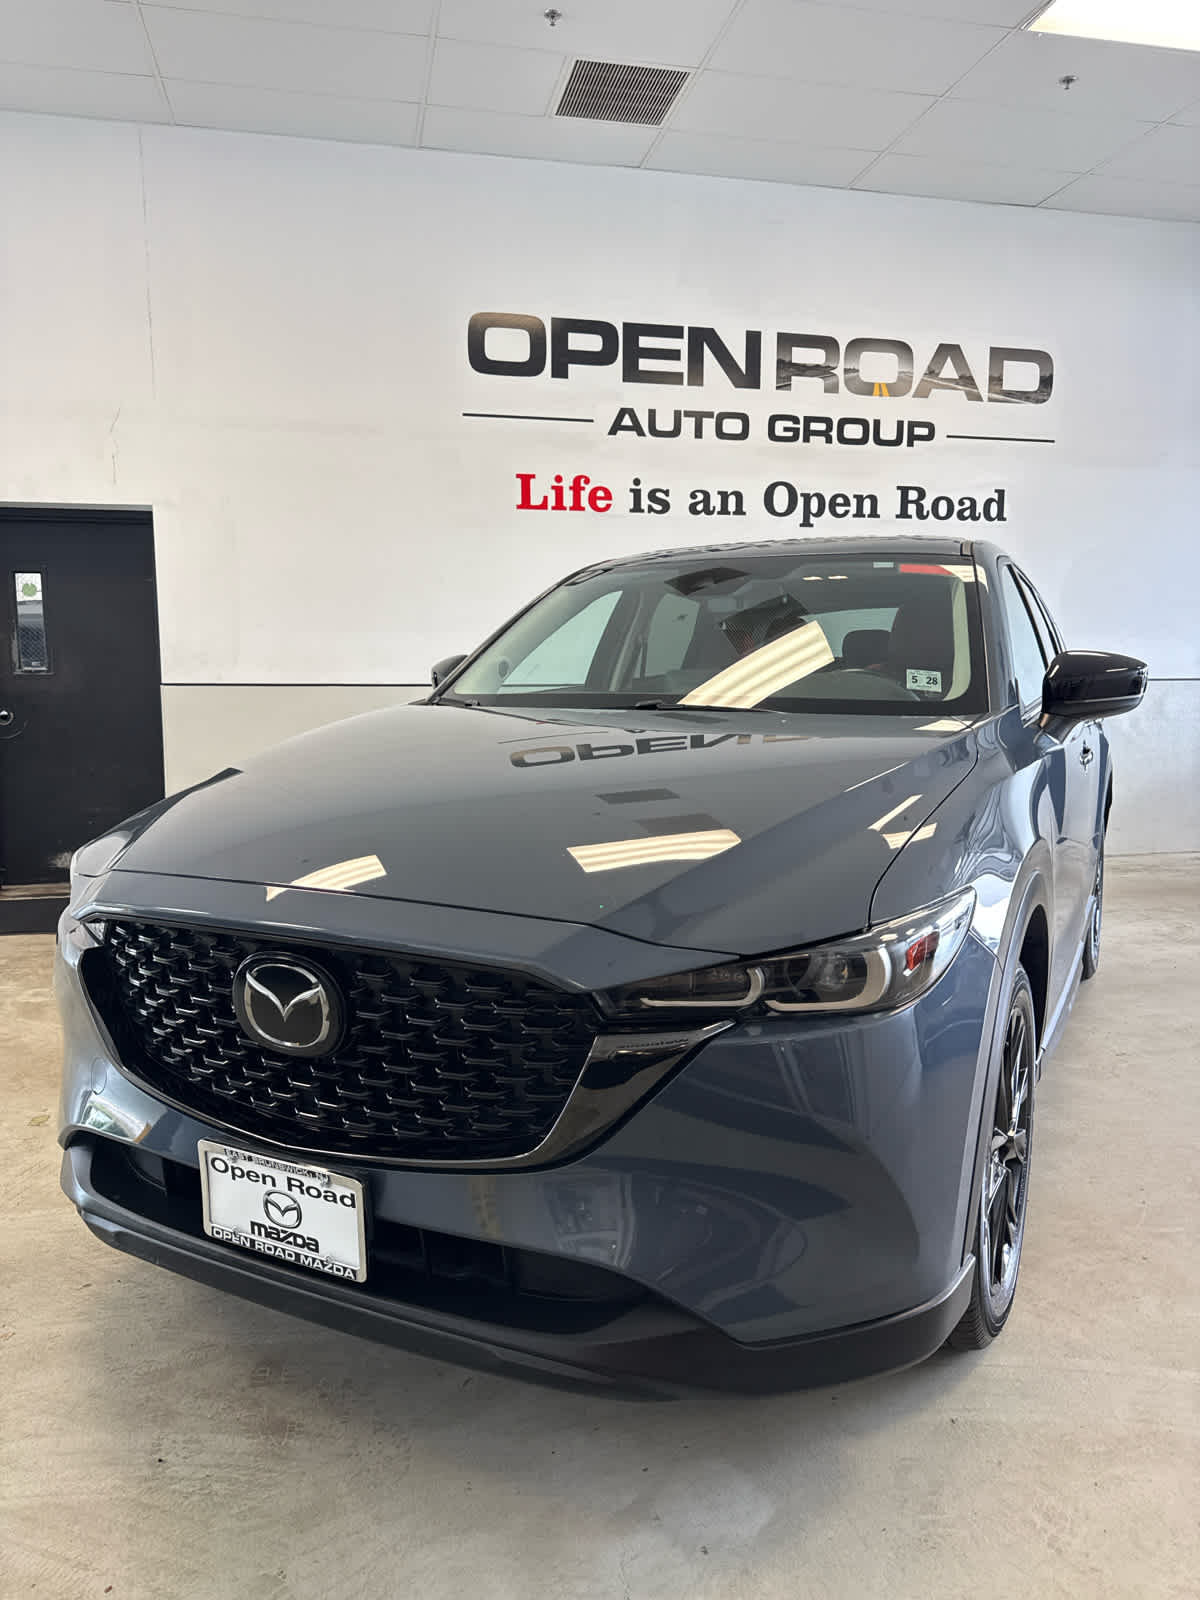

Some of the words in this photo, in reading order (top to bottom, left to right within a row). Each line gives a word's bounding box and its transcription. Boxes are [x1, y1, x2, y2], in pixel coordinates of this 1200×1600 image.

[467, 311, 762, 390] OPEN
[775, 331, 1055, 405] ROAD
[607, 407, 750, 441] AUTO
[767, 412, 936, 448] GROUP
[515, 473, 613, 513] Life
[629, 477, 671, 515] is
[688, 489, 746, 517] an
[763, 480, 881, 528] Open
[895, 486, 1007, 522] Road
[911, 675, 918, 684] 5
[926, 676, 938, 686] 28
[210, 1157, 277, 1188] Open
[286, 1176, 357, 1209] Road
[213, 1226, 251, 1248] OPEN
[254, 1241, 296, 1262] ROAD
[300, 1254, 356, 1281] MAZDA
